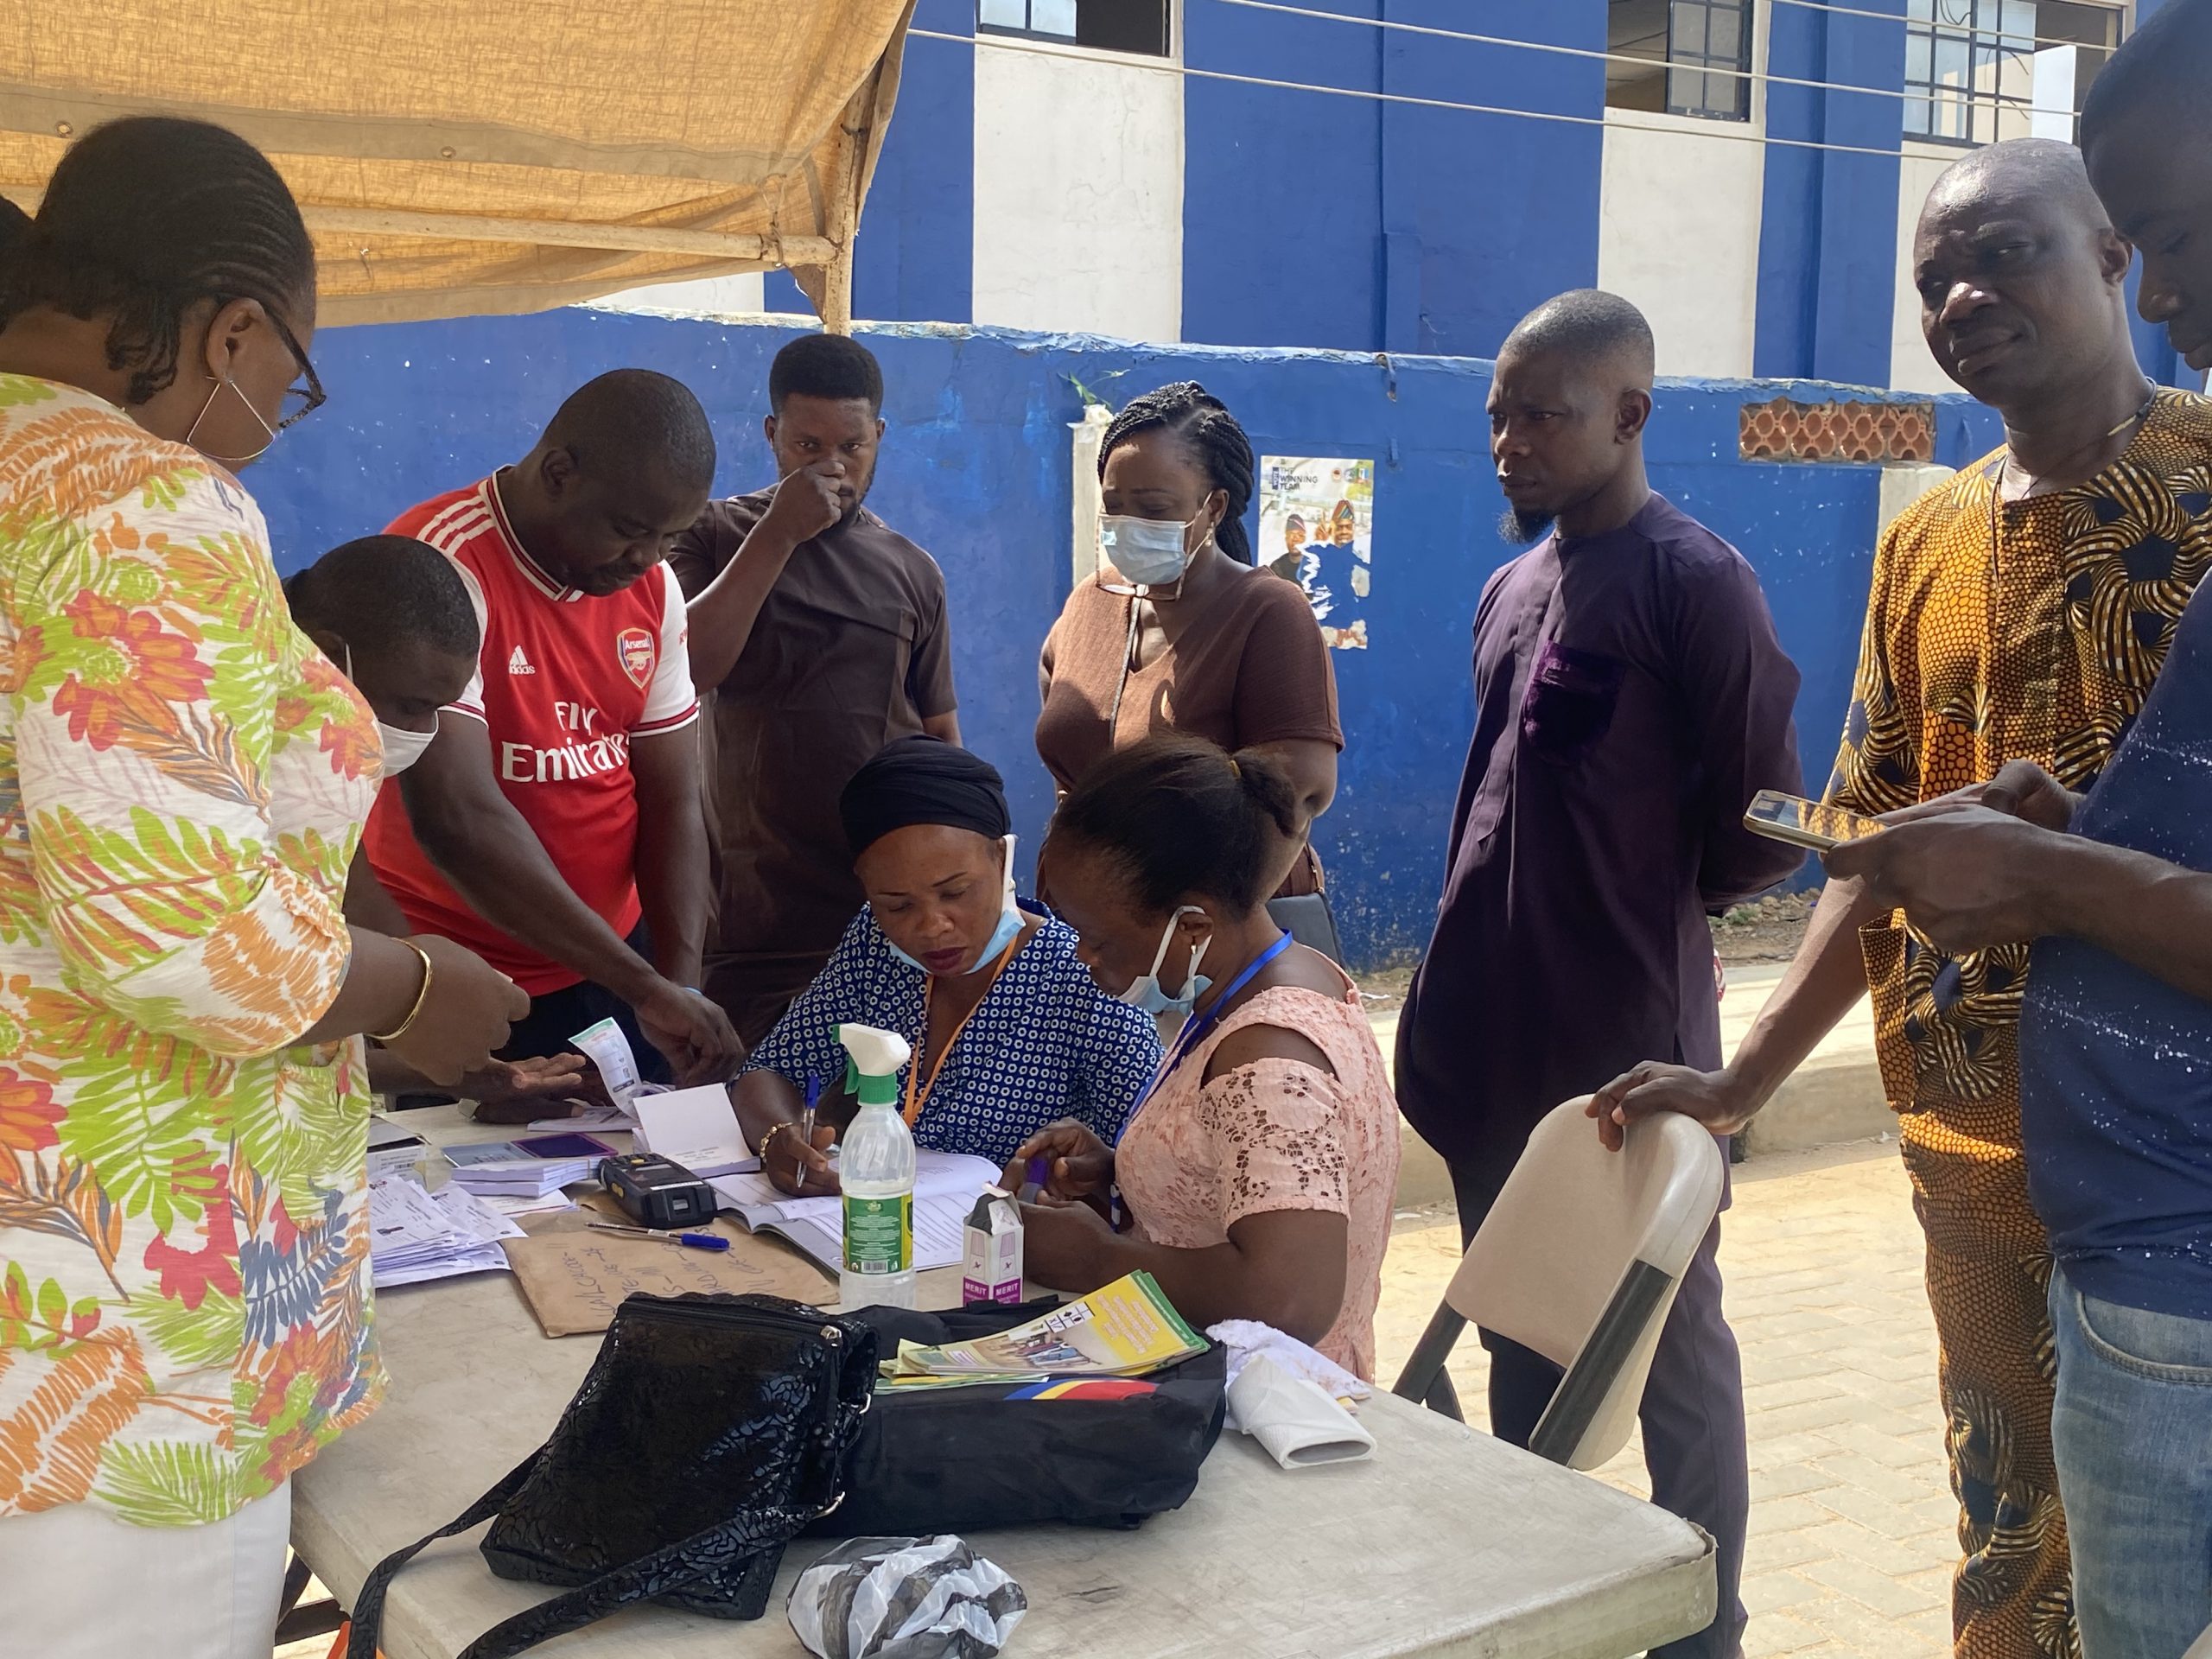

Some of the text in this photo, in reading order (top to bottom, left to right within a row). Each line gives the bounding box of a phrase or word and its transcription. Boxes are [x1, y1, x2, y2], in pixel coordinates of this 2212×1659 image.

[1280, 475, 1318, 484] WINNING
[625, 639, 650, 649] Arsenal
[554, 701, 598, 736] Fly
[501, 733, 630, 783] Emirate
[964, 1281, 988, 1295] MERIT
[995, 1282, 1019, 1296] MERIT
